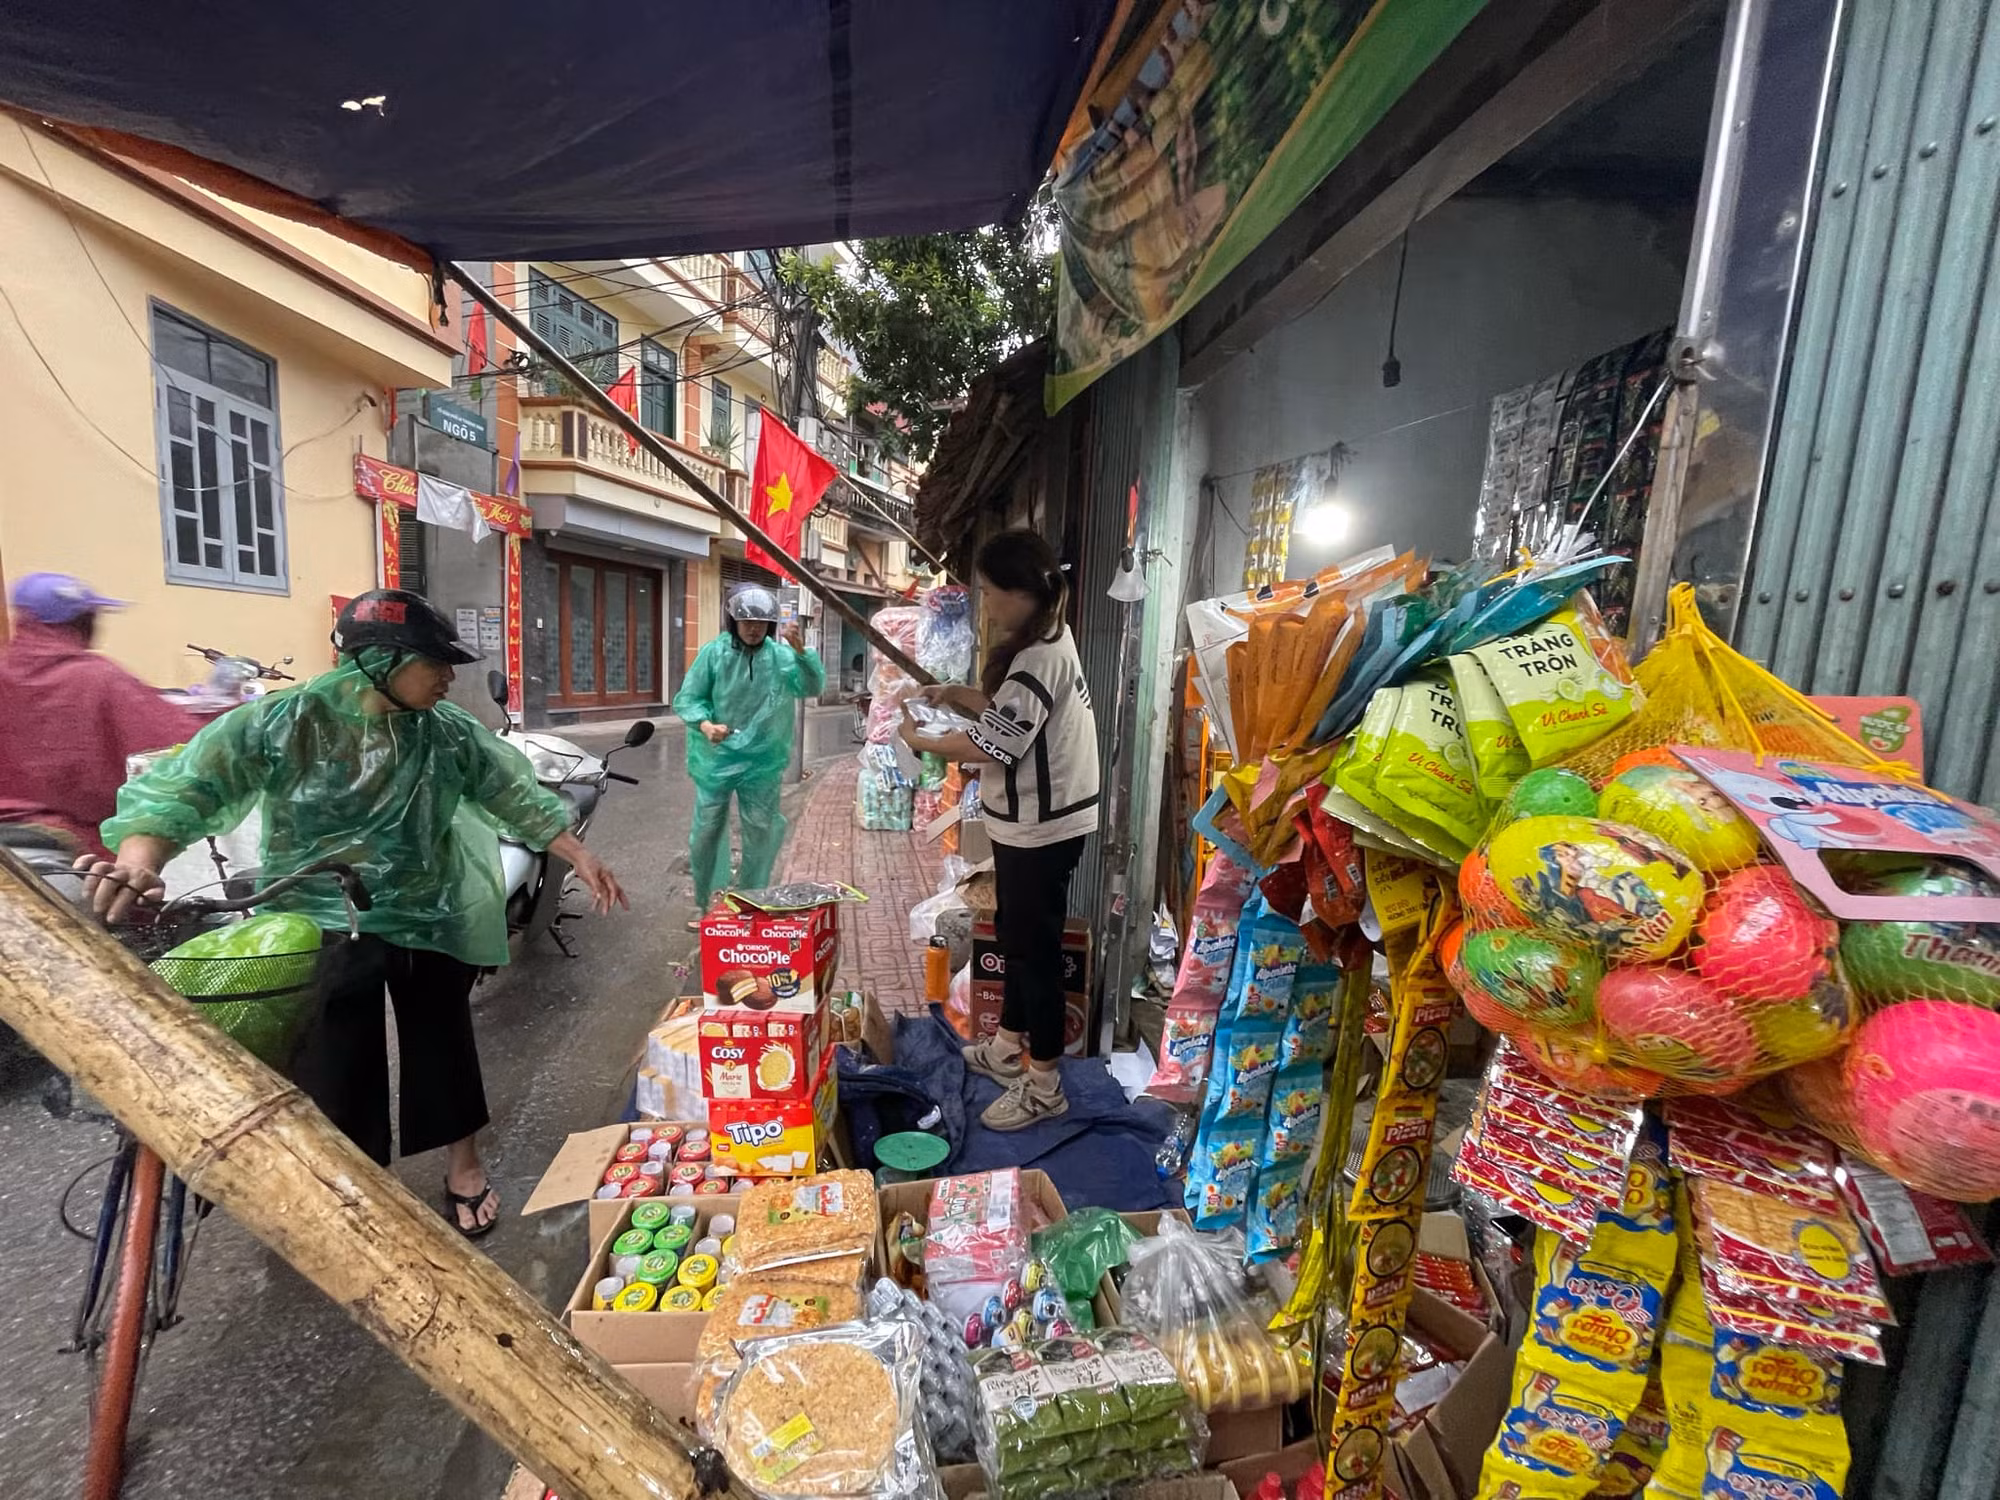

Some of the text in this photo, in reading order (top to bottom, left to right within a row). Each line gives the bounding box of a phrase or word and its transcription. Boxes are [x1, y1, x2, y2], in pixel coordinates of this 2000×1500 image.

[443, 419, 468, 440] NGÕ
[469, 431, 476, 441] 5
[1519, 653, 1578, 677] TRỘN
[1541, 711, 1557, 729] Vị
[967, 725, 1014, 766] adidas
[705, 927, 750, 937] ChocoPie
[762, 928, 808, 939] ChocoPie
[719, 948, 791, 965] ChocoPie
[711, 1046, 745, 1060] COSY
[719, 1070, 743, 1082] Marie
[1386, 1124, 1427, 1142] Pizza
[1567, 1332, 1625, 1357] Chupa
